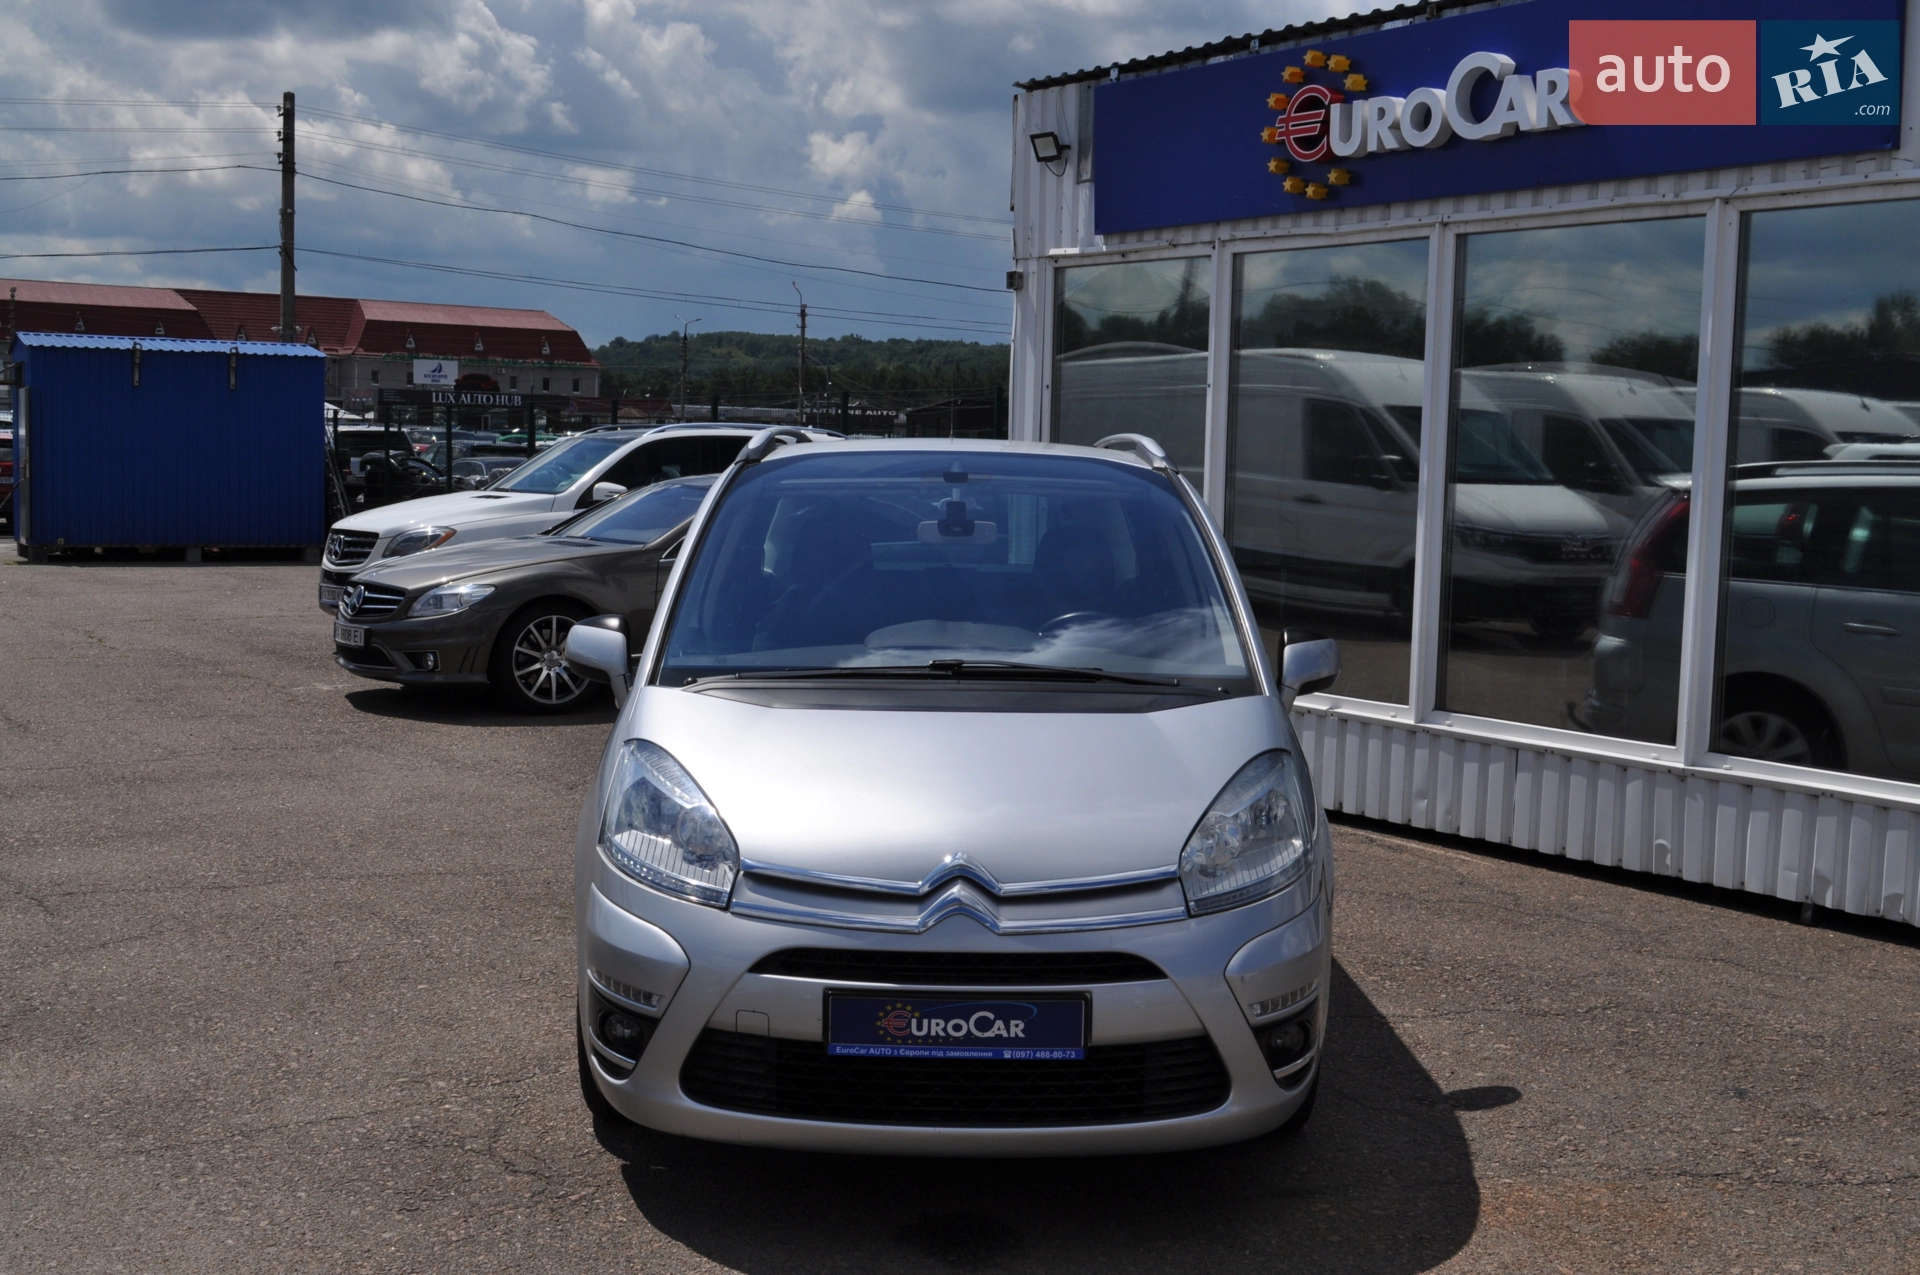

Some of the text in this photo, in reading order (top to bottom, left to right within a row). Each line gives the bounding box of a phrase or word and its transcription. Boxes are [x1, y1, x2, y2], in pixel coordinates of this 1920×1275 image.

[431, 392, 522, 406] LUX AUTO HUB
[836, 1046, 868, 1054] EuroCar
[869, 1047, 892, 1055] AUTO
[899, 1048, 930, 1057] Європи
[931, 1049, 944, 1057] під
[945, 1050, 993, 1058] замовлення
[1012, 1050, 1034, 1059] (097)
[1035, 1050, 1076, 1059] 488-80-73
